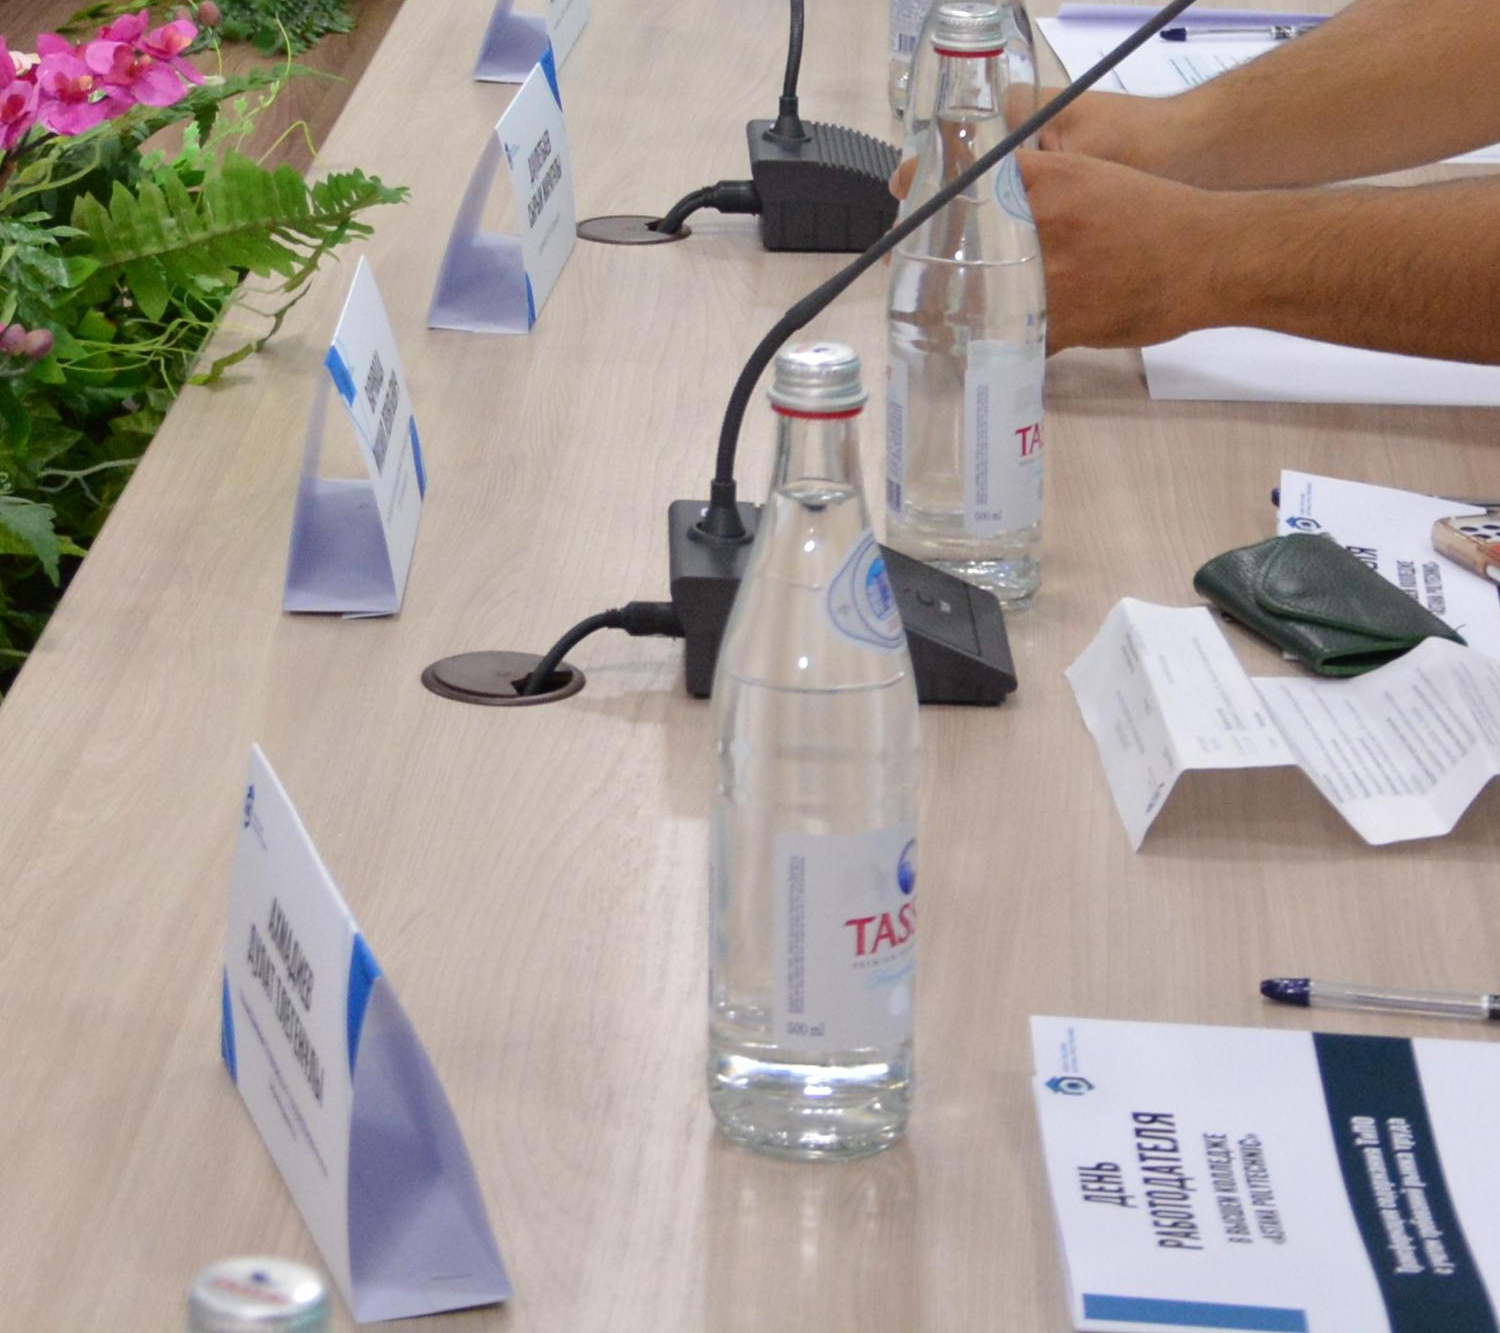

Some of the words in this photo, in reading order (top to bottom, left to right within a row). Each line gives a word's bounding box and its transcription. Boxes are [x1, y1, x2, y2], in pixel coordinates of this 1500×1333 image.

[844, 900, 916, 957] TAS
[1078, 1161, 1139, 1209] ДЕНЬ
[1132, 1111, 1204, 1251] РАБОТОДАТЕЛЯ
[1203, 1132, 1239, 1196] КОЛЛЕДЖЕ
